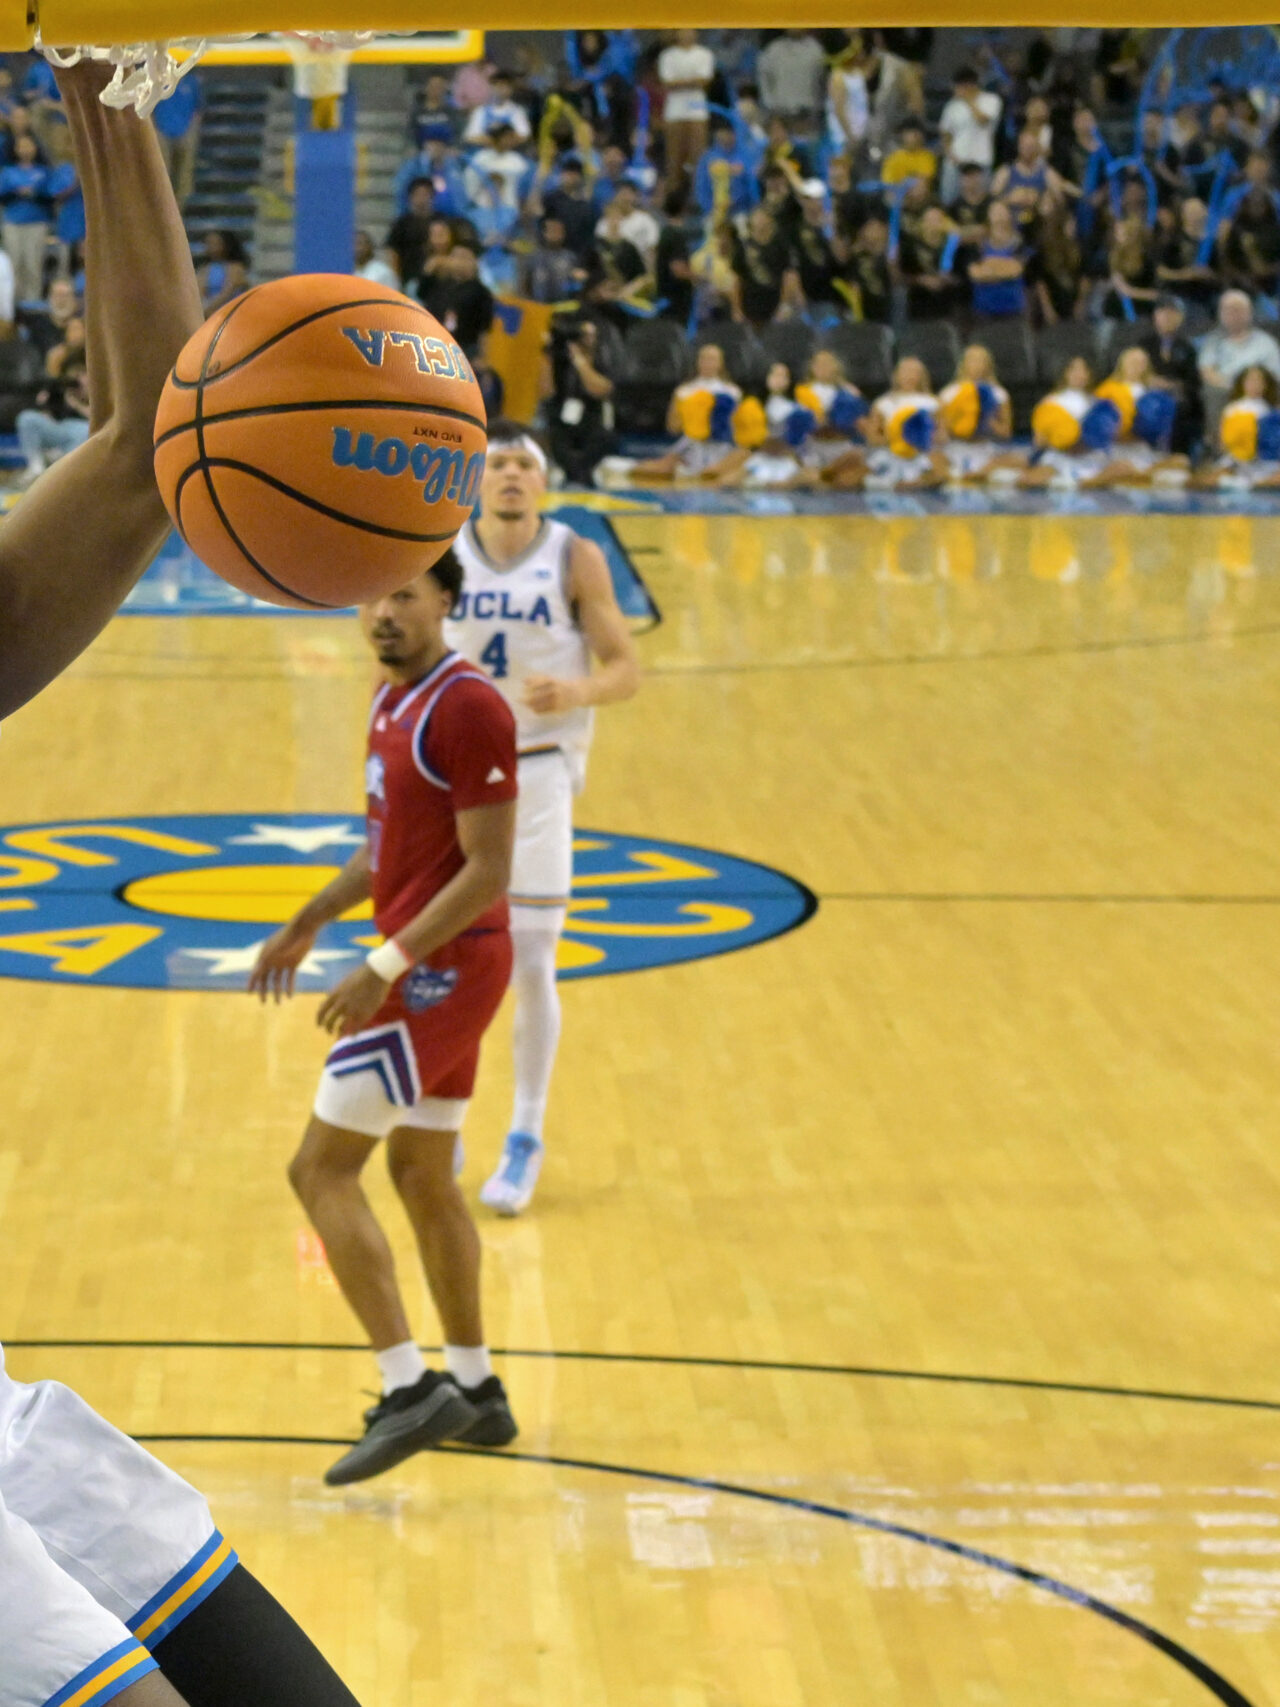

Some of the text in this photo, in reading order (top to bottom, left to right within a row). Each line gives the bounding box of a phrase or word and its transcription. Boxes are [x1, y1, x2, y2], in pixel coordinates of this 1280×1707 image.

[341, 327, 475, 383] UCLA
[412, 426, 439, 440] NXT
[332, 426, 486, 520] Wilson
[448, 592, 552, 626] UCLA
[481, 632, 507, 678] 4
